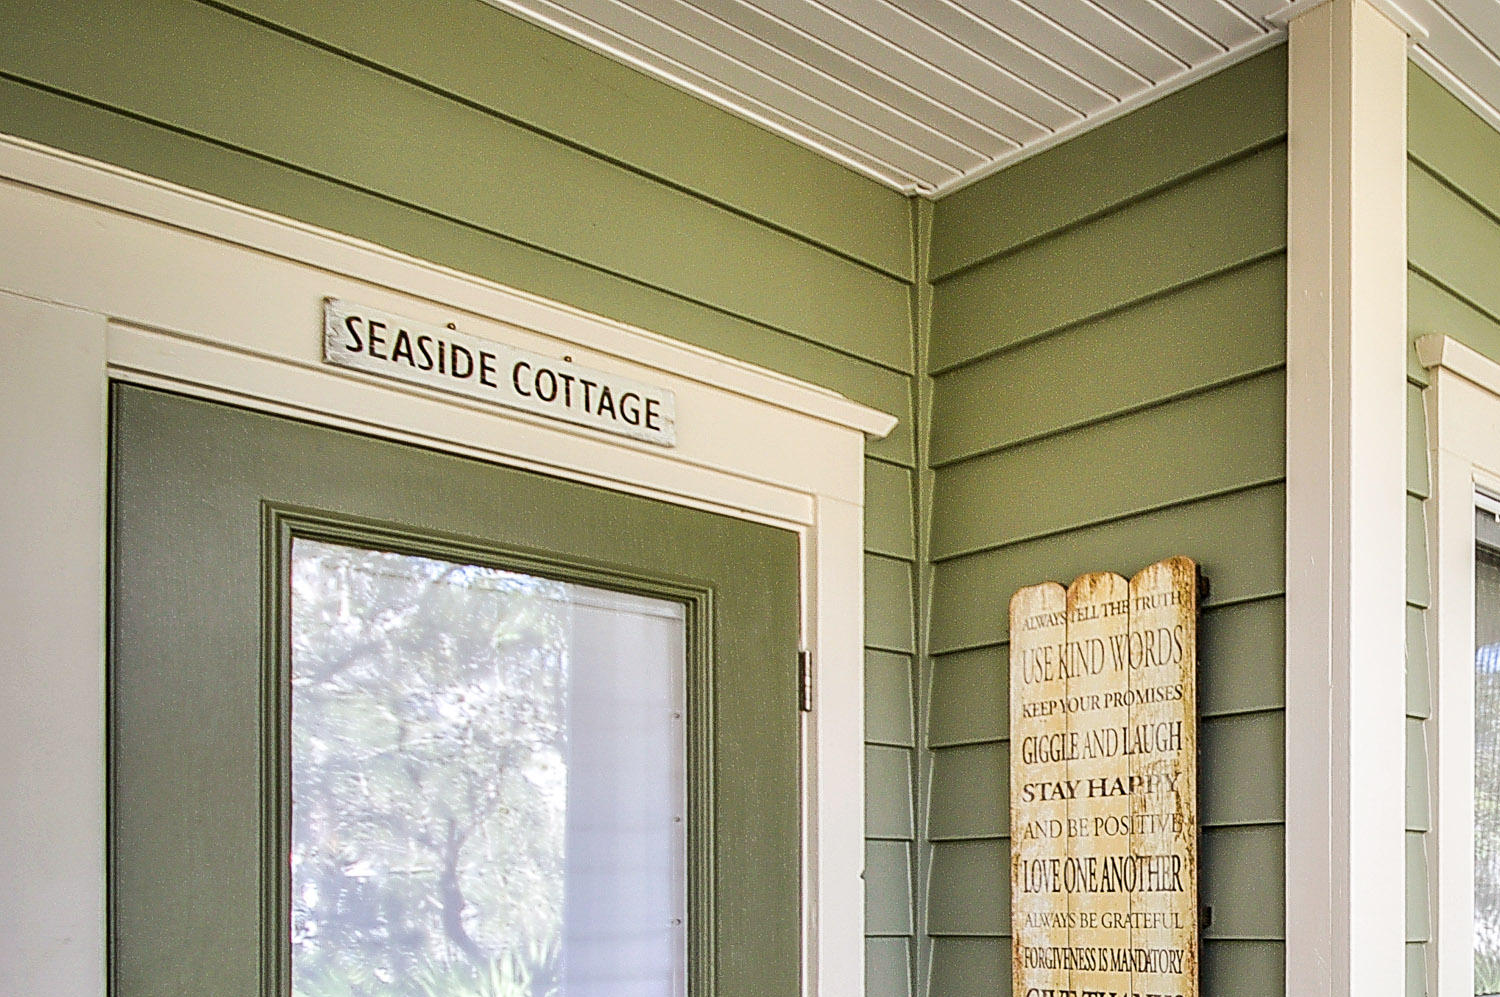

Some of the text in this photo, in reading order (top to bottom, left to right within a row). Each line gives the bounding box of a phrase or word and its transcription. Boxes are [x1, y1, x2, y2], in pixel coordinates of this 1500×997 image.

[345, 315, 661, 431] SEASIDE COTTAGE
[1023, 591, 1181, 631] ALWAYS TELL THE TRUTH
[1023, 625, 1183, 684] USE KIND WORDS
[1023, 684, 1183, 718] KEEP YOUR PROMISES
[1022, 721, 1182, 764] GIGGLE AND LAUGH
[1022, 771, 1182, 802] STAY HAPPY
[1024, 813, 1183, 839] AND BE POSITIVE
[1024, 855, 1183, 893] LOVE ONE ANOTHER
[1025, 913, 1184, 929] ALWAYS BE GRATEFUL
[1025, 947, 1184, 974] FORGIVENESS IS MANDATORY
